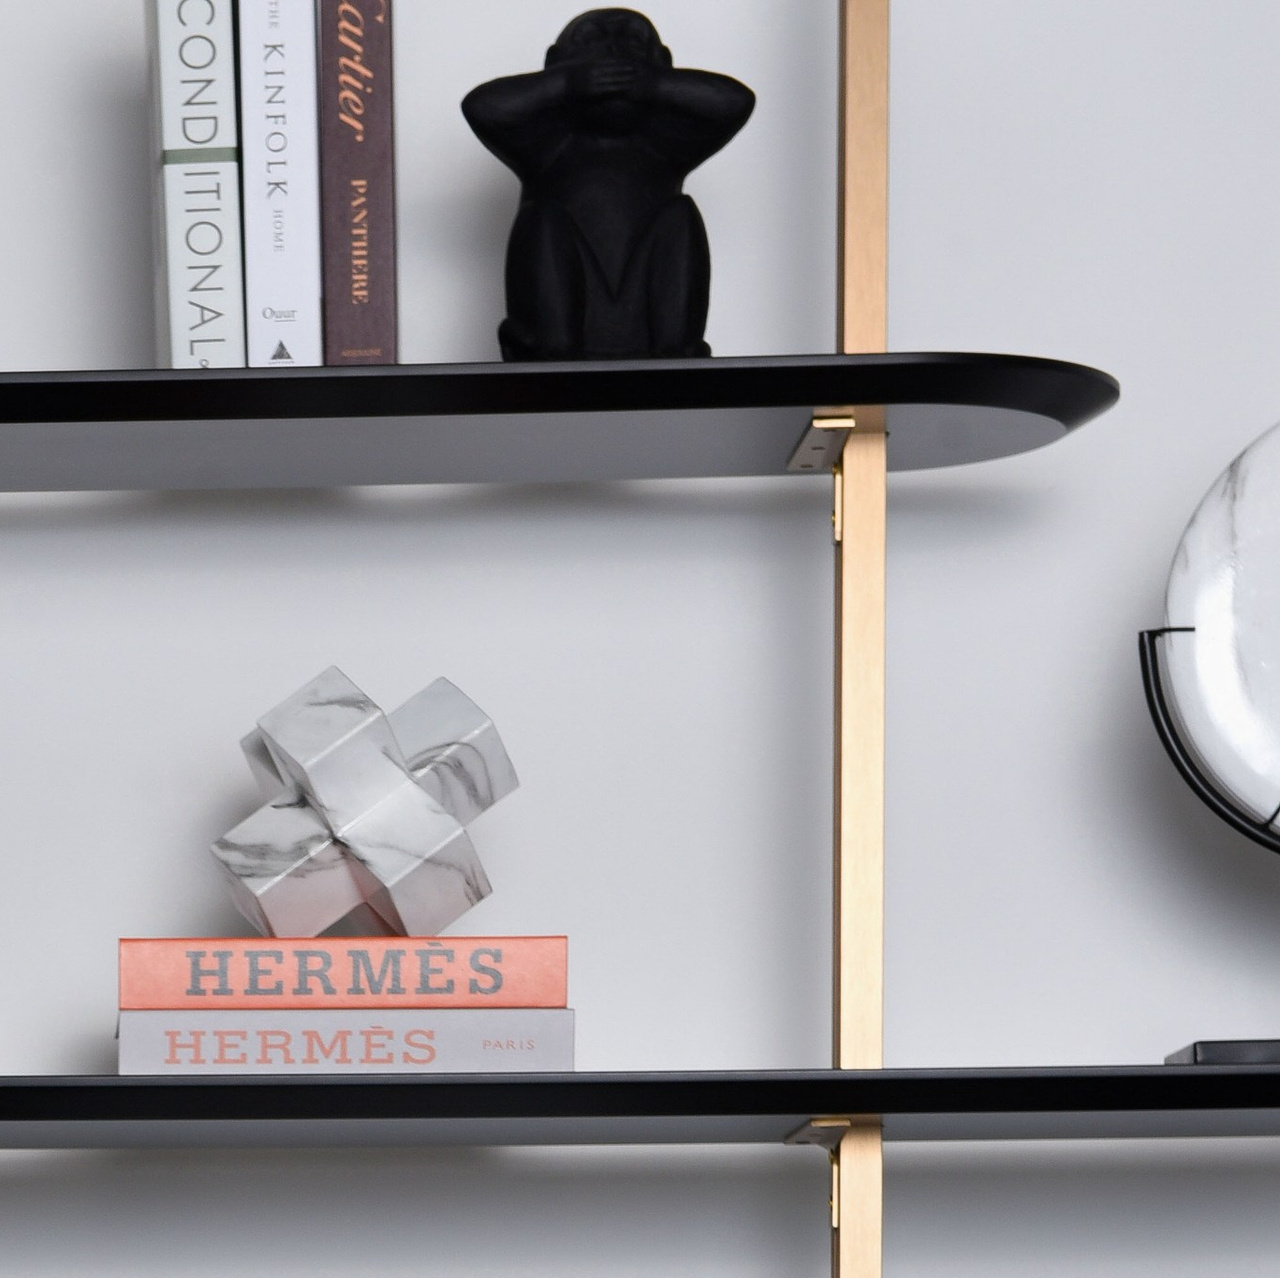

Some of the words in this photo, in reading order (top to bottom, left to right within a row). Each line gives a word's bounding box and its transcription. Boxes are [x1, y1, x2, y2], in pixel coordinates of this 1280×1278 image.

[264, 43, 288, 200] KINFOLK
[272, 209, 285, 253] HOME
[481, 1038, 536, 1052] PARIS
